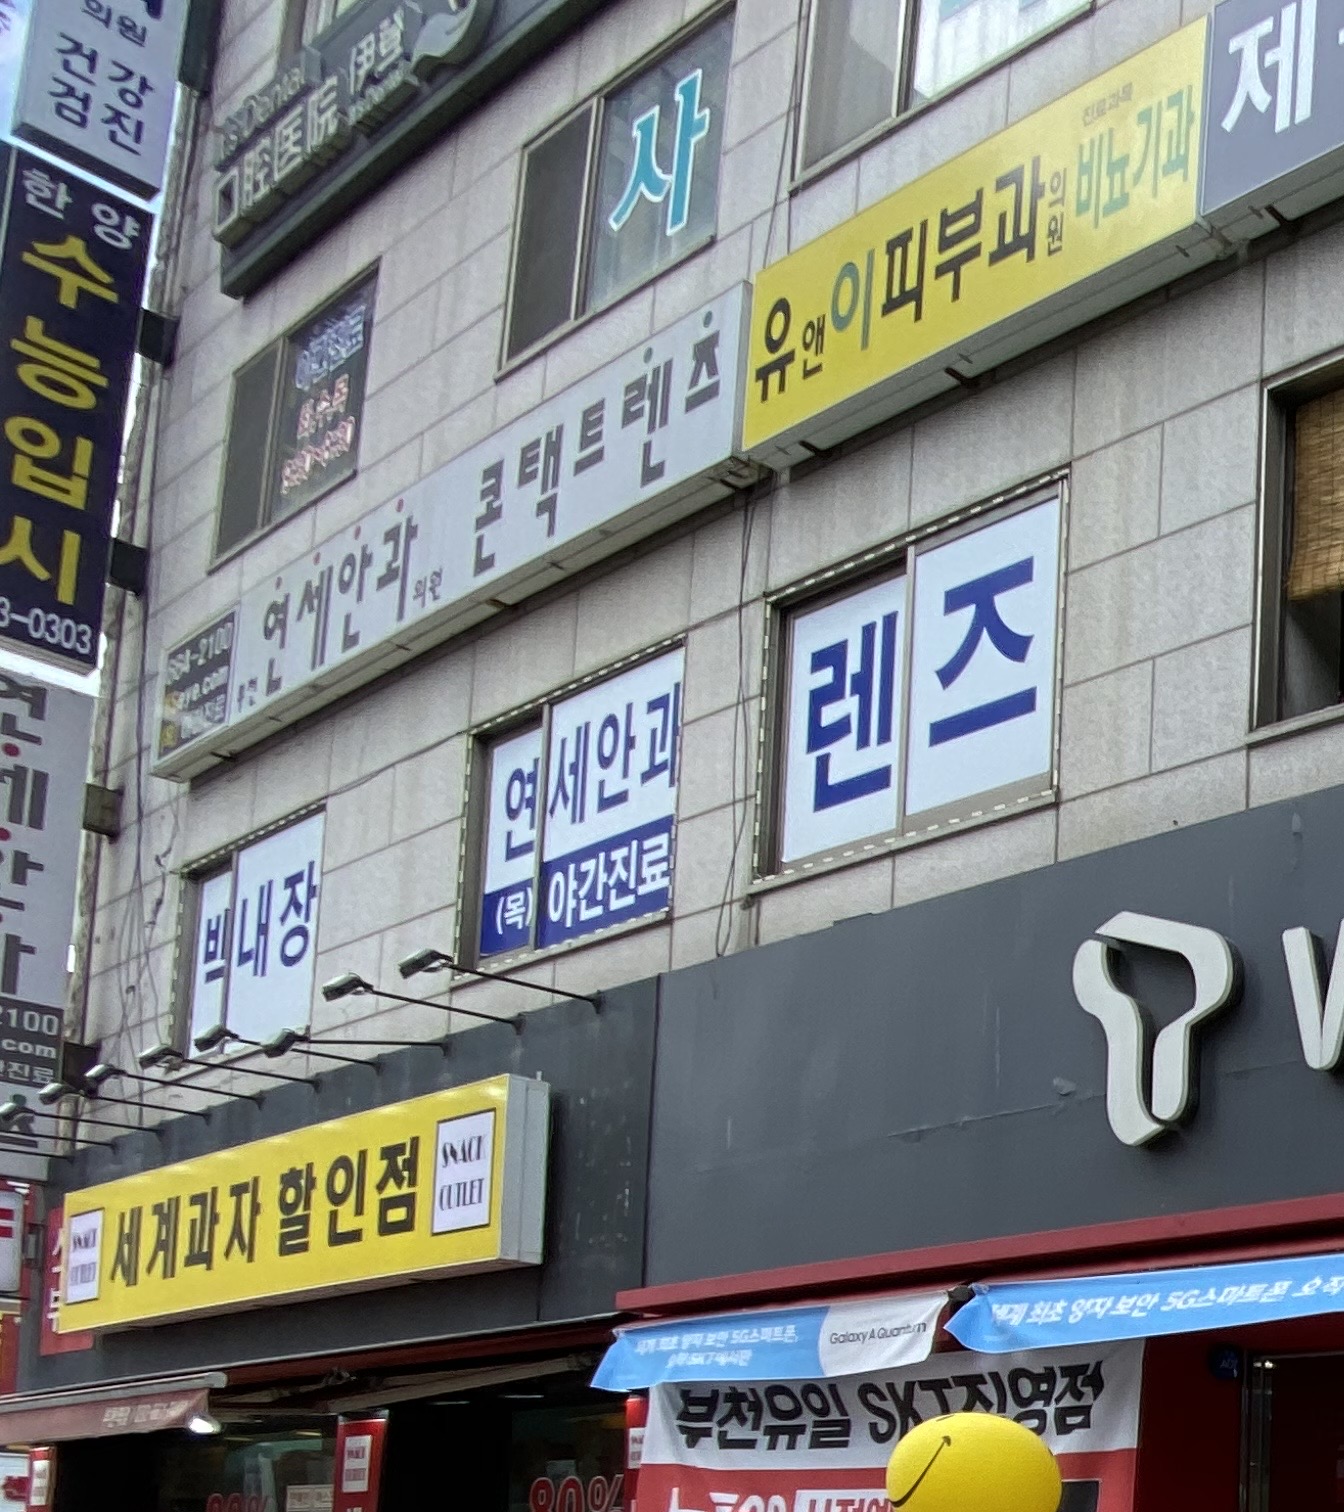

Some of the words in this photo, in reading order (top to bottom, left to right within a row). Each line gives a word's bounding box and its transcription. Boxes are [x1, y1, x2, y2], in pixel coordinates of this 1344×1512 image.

[610, 68, 711, 236] 사
[23, 168, 140, 252] 한양
[755, 155, 1049, 402] 유앤이피부과
[1076, 85, 1195, 230] 비뇨기과
[263, 513, 418, 697] 연세안과
[474, 322, 720, 578] 콘택트렌즈
[804, 555, 1038, 813] 렌즈
[504, 683, 681, 862] 연세안과
[548, 834, 671, 930] 야간진료
[0, 1005, 59, 1036] 100
[0, 1060, 54, 1084] 진료
[441, 1134, 484, 1169] SNACK
[111, 1175, 261, 1287] 세계과자
[278, 1135, 421, 1257] 할인점
[830, 1330, 869, 1345] Galaxy
[676, 1383, 851, 1450] 부천유일
